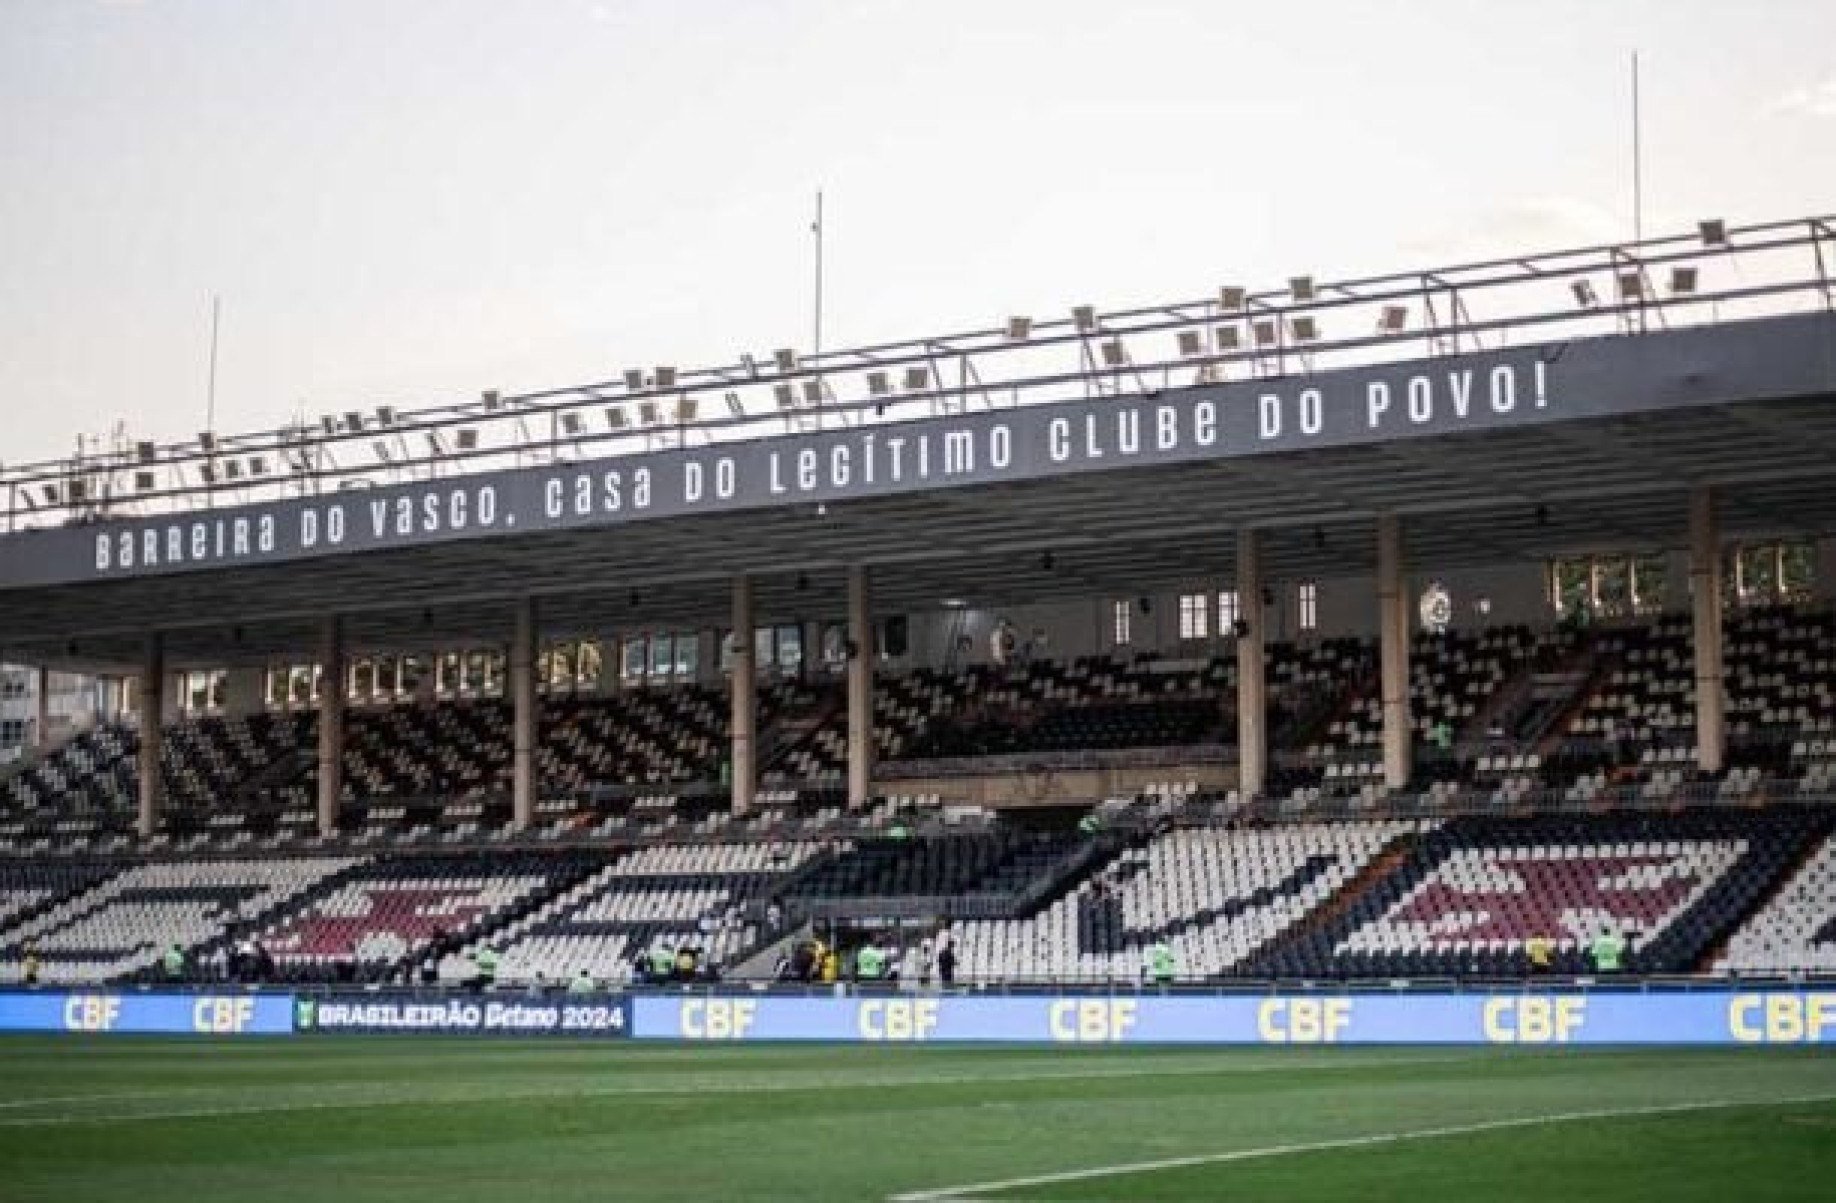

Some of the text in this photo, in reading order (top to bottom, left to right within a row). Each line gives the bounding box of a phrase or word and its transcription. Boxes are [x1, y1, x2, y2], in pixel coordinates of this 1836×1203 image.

[299, 504, 345, 548] DO
[685, 456, 737, 503] DO
[1259, 387, 1324, 440] DO
[1368, 360, 1549, 428] POVO!
[65, 996, 120, 1030] CBF
[194, 997, 254, 1031] CBF
[318, 999, 480, 1028] BRASILEIRÃO
[561, 1006, 624, 1029] 2024
[680, 998, 756, 1038] CBF
[859, 998, 939, 1038] CBF
[1050, 998, 1137, 1039] CBF
[1257, 998, 1352, 1041] CBF
[1483, 997, 1586, 1041] CBF
[1730, 995, 1836, 1041] CBF
